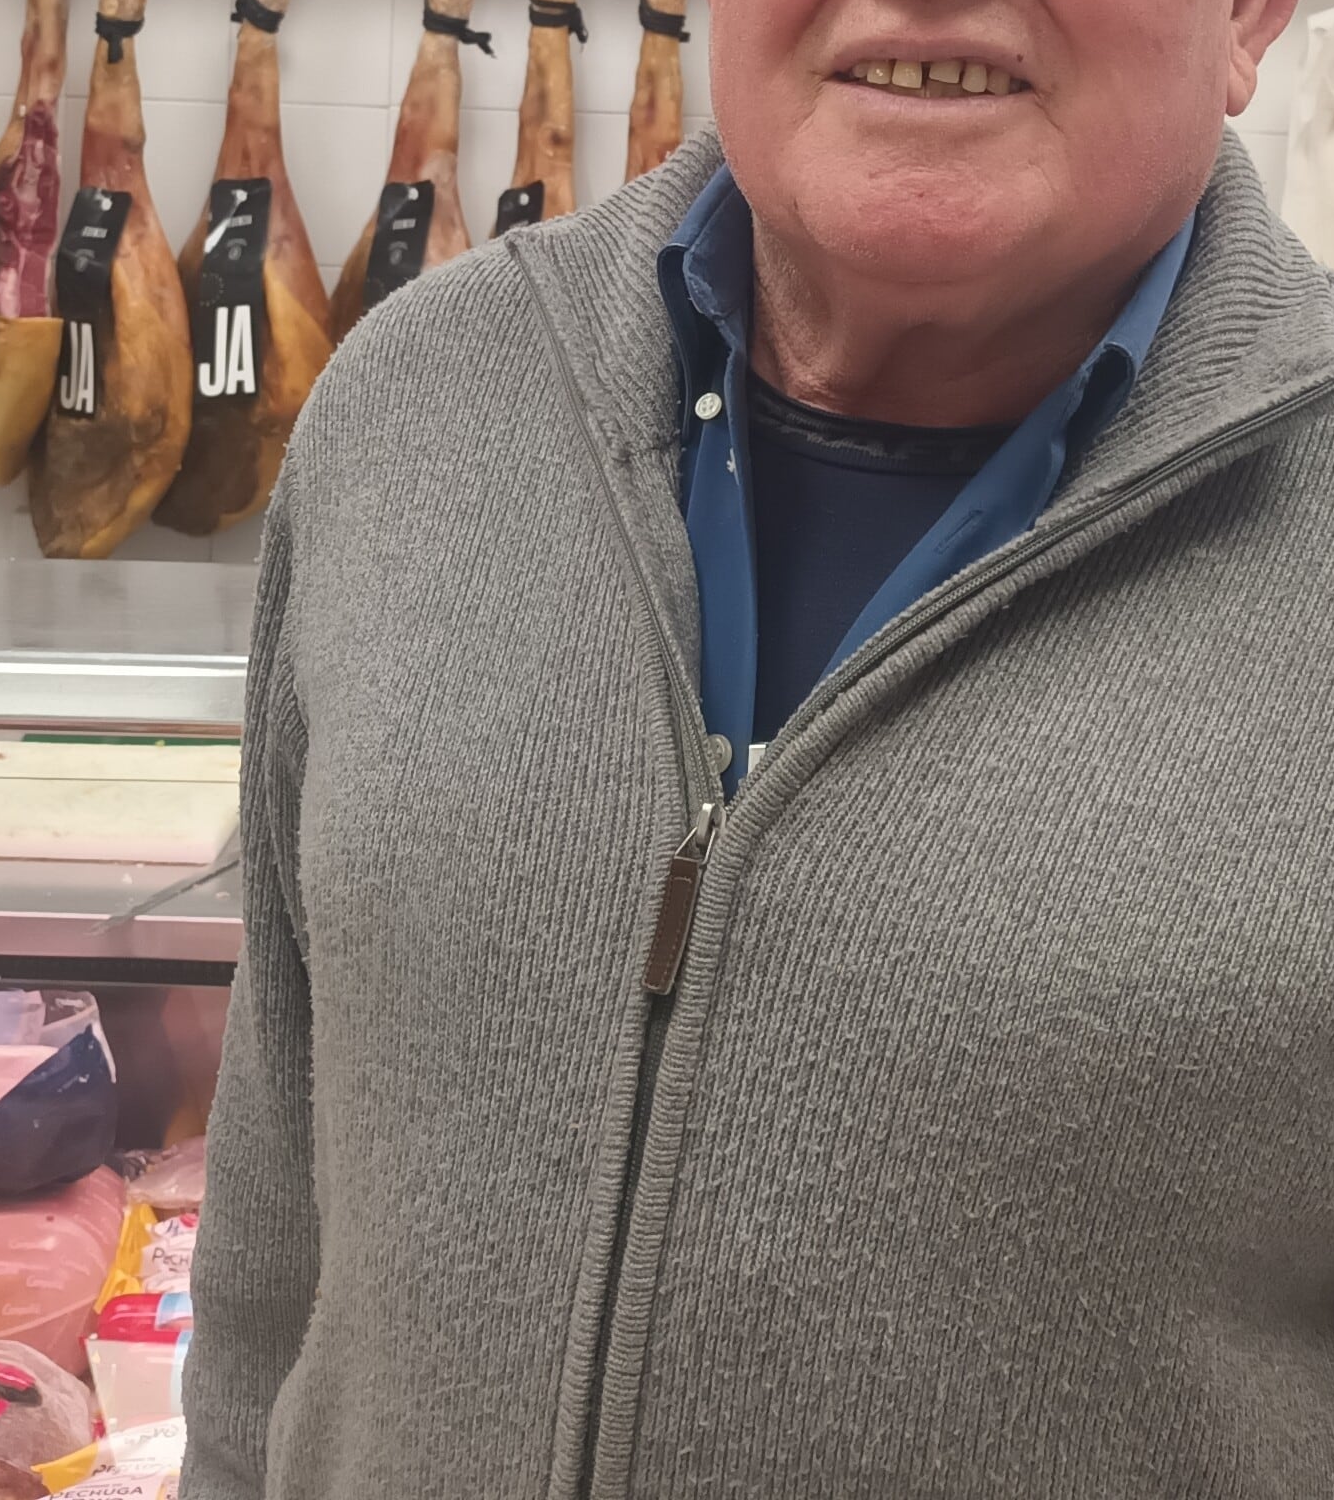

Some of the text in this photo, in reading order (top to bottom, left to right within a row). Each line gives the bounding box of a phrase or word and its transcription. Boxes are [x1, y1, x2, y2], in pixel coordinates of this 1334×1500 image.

[60, 321, 96, 415] JA
[198, 304, 256, 398] JA
[152, 1246, 189, 1267] PECH
